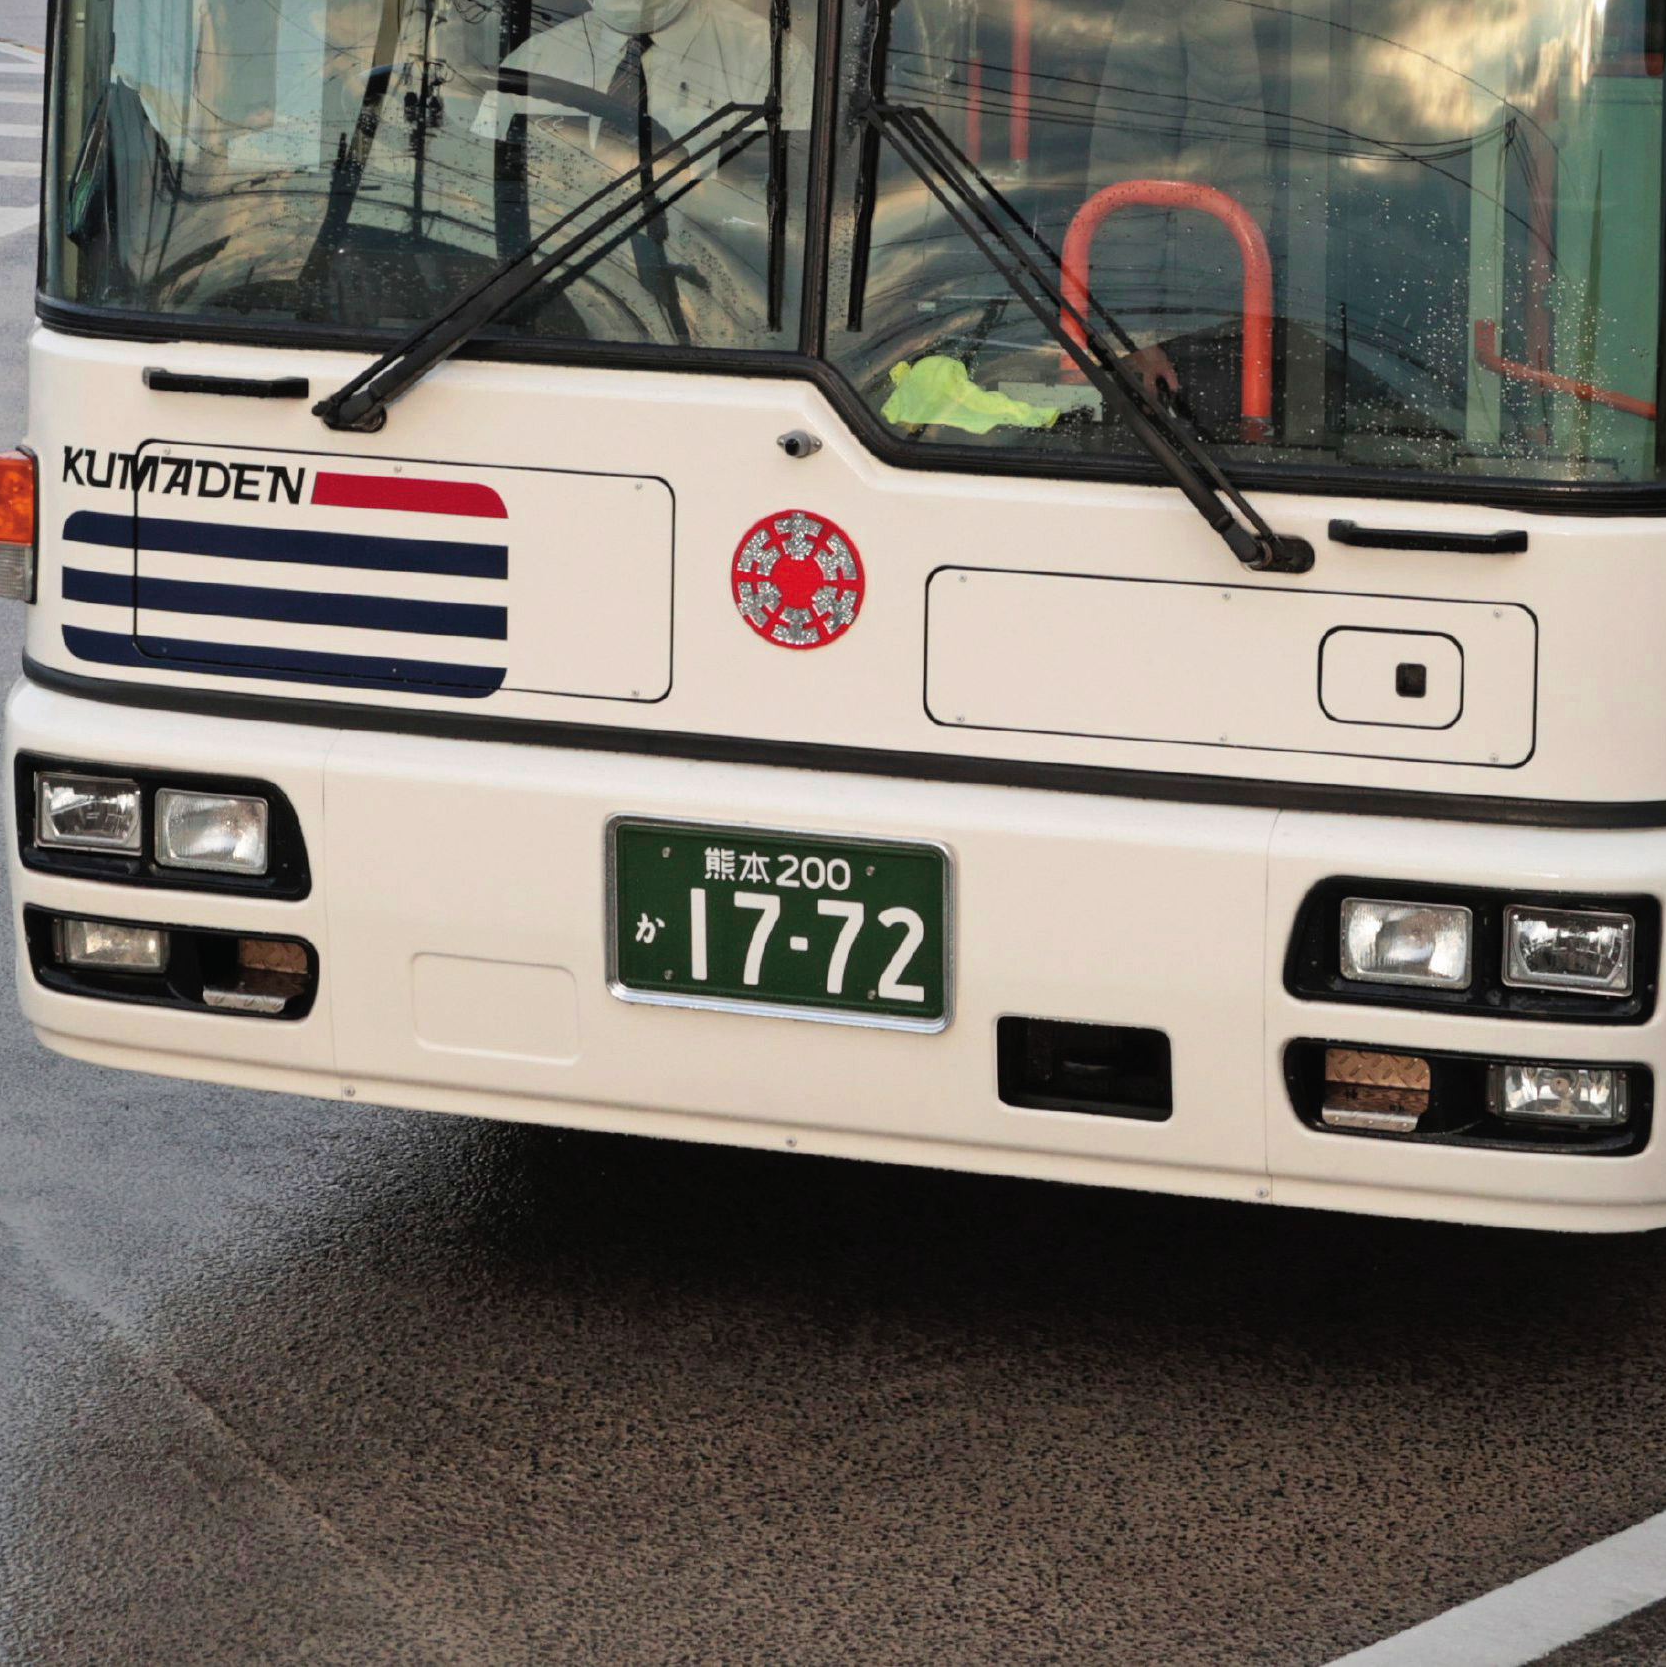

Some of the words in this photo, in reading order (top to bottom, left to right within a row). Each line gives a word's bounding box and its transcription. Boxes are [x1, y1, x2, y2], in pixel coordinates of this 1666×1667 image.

[62, 446, 306, 505] KUMADEN
[704, 847, 851, 891] 熊本200
[635, 913, 665, 943] か
[690, 888, 925, 1002] 17-72
